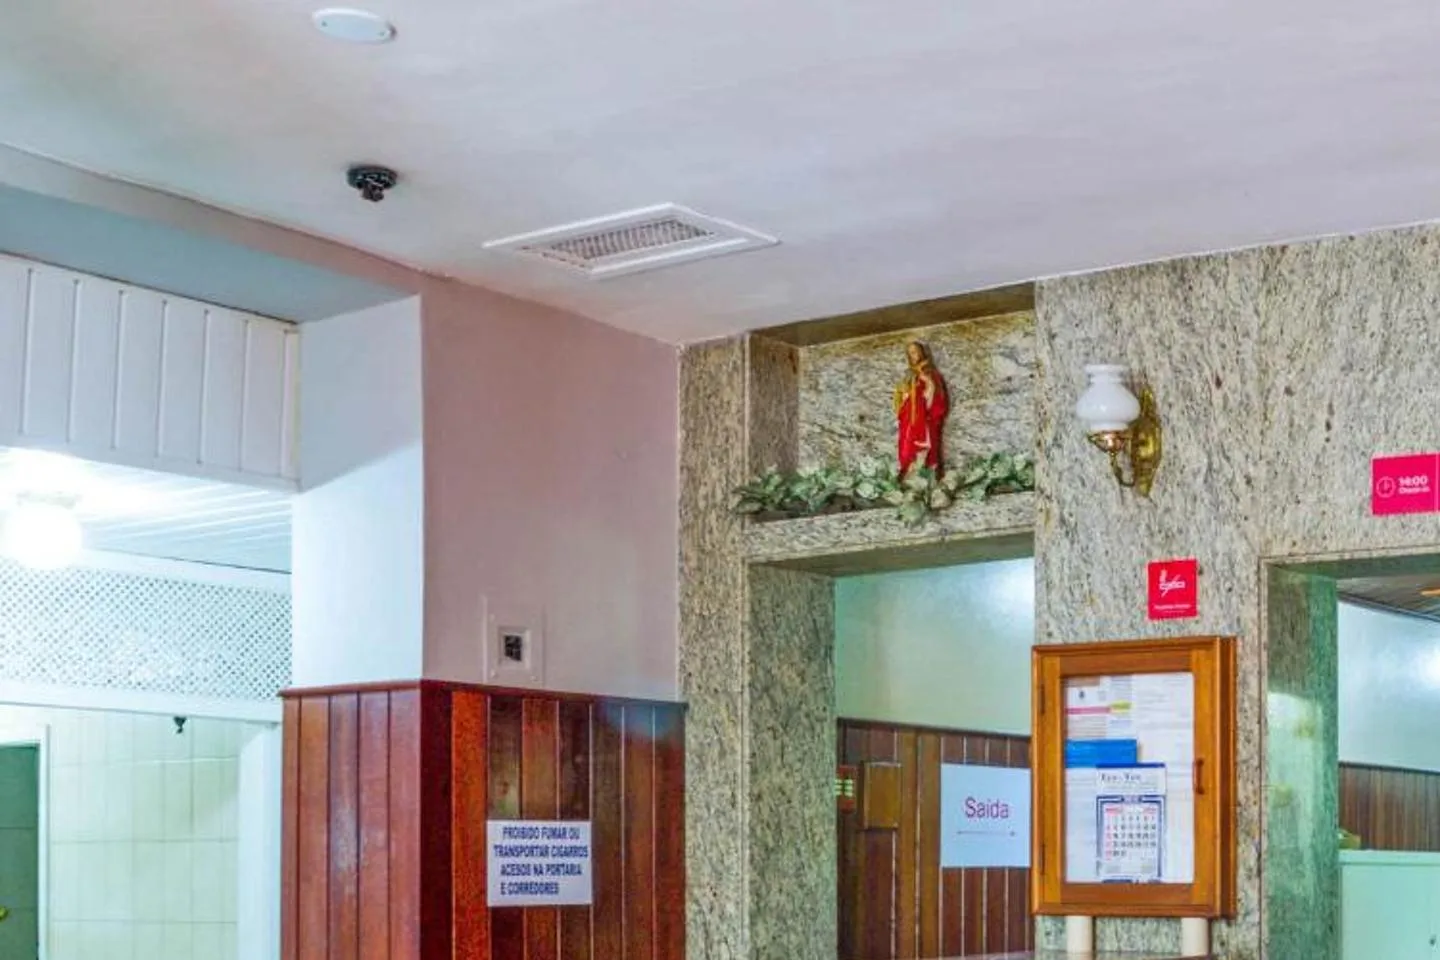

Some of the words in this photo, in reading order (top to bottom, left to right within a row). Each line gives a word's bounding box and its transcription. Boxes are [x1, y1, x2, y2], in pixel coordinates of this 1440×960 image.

[502, 826, 540, 840] PROIBIDO
[541, 826, 568, 840] FUMAR
[568, 826, 580, 840] OU
[493, 844, 549, 858] TRANSPORTAR
[550, 844, 589, 858] CIGARROS
[500, 863, 531, 876] ACESOS
[532, 863, 544, 876] NA
[545, 863, 582, 876] PORTARIA
[500, 881, 506, 895] E
[507, 881, 559, 895] CORREDORES
